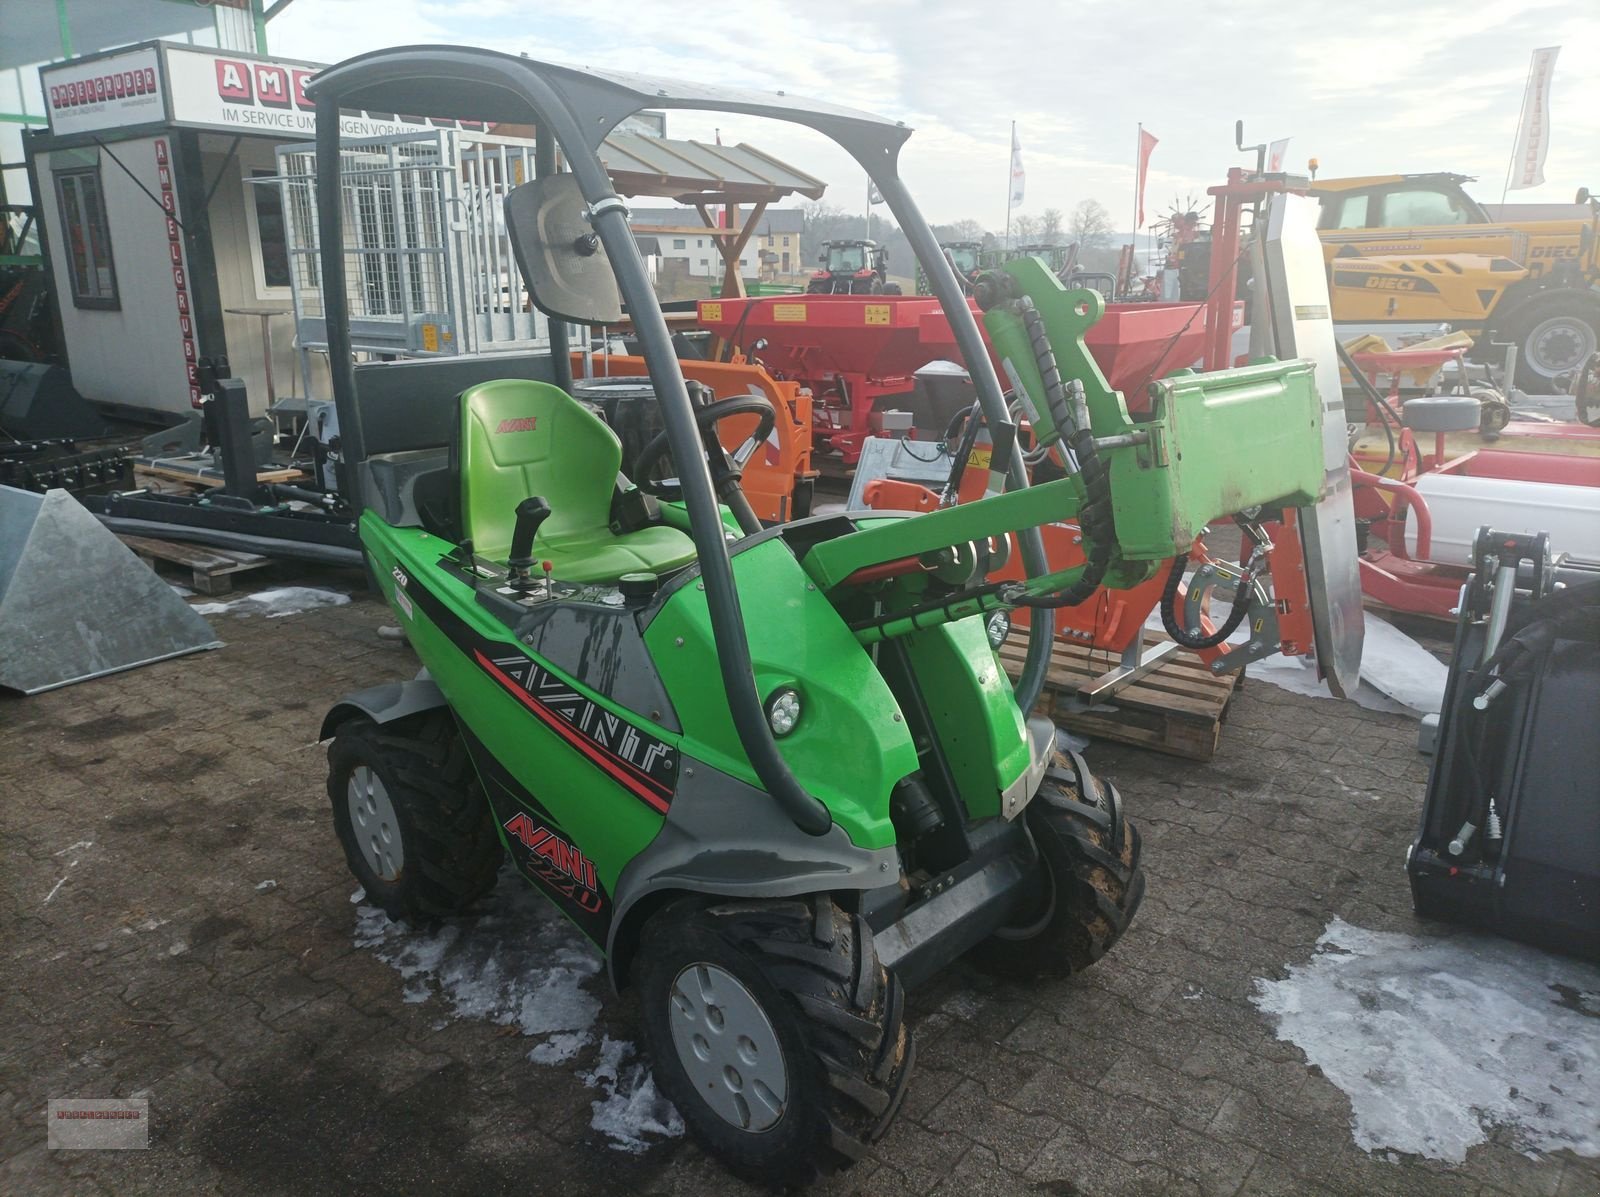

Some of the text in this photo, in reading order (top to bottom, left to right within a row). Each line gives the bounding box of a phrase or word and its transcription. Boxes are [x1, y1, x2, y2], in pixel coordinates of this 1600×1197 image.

[51, 69, 155, 106] AMSELGRUBER
[222, 108, 240, 122] IM
[242, 110, 295, 128] SERVICE
[340, 119, 369, 135] NGEN
[155, 139, 202, 409] AMSELGRUBER
[1365, 276, 1417, 291] DIECI
[491, 655, 674, 773] AVANT
[503, 811, 597, 892] AVANT
[525, 853, 602, 913] 220
